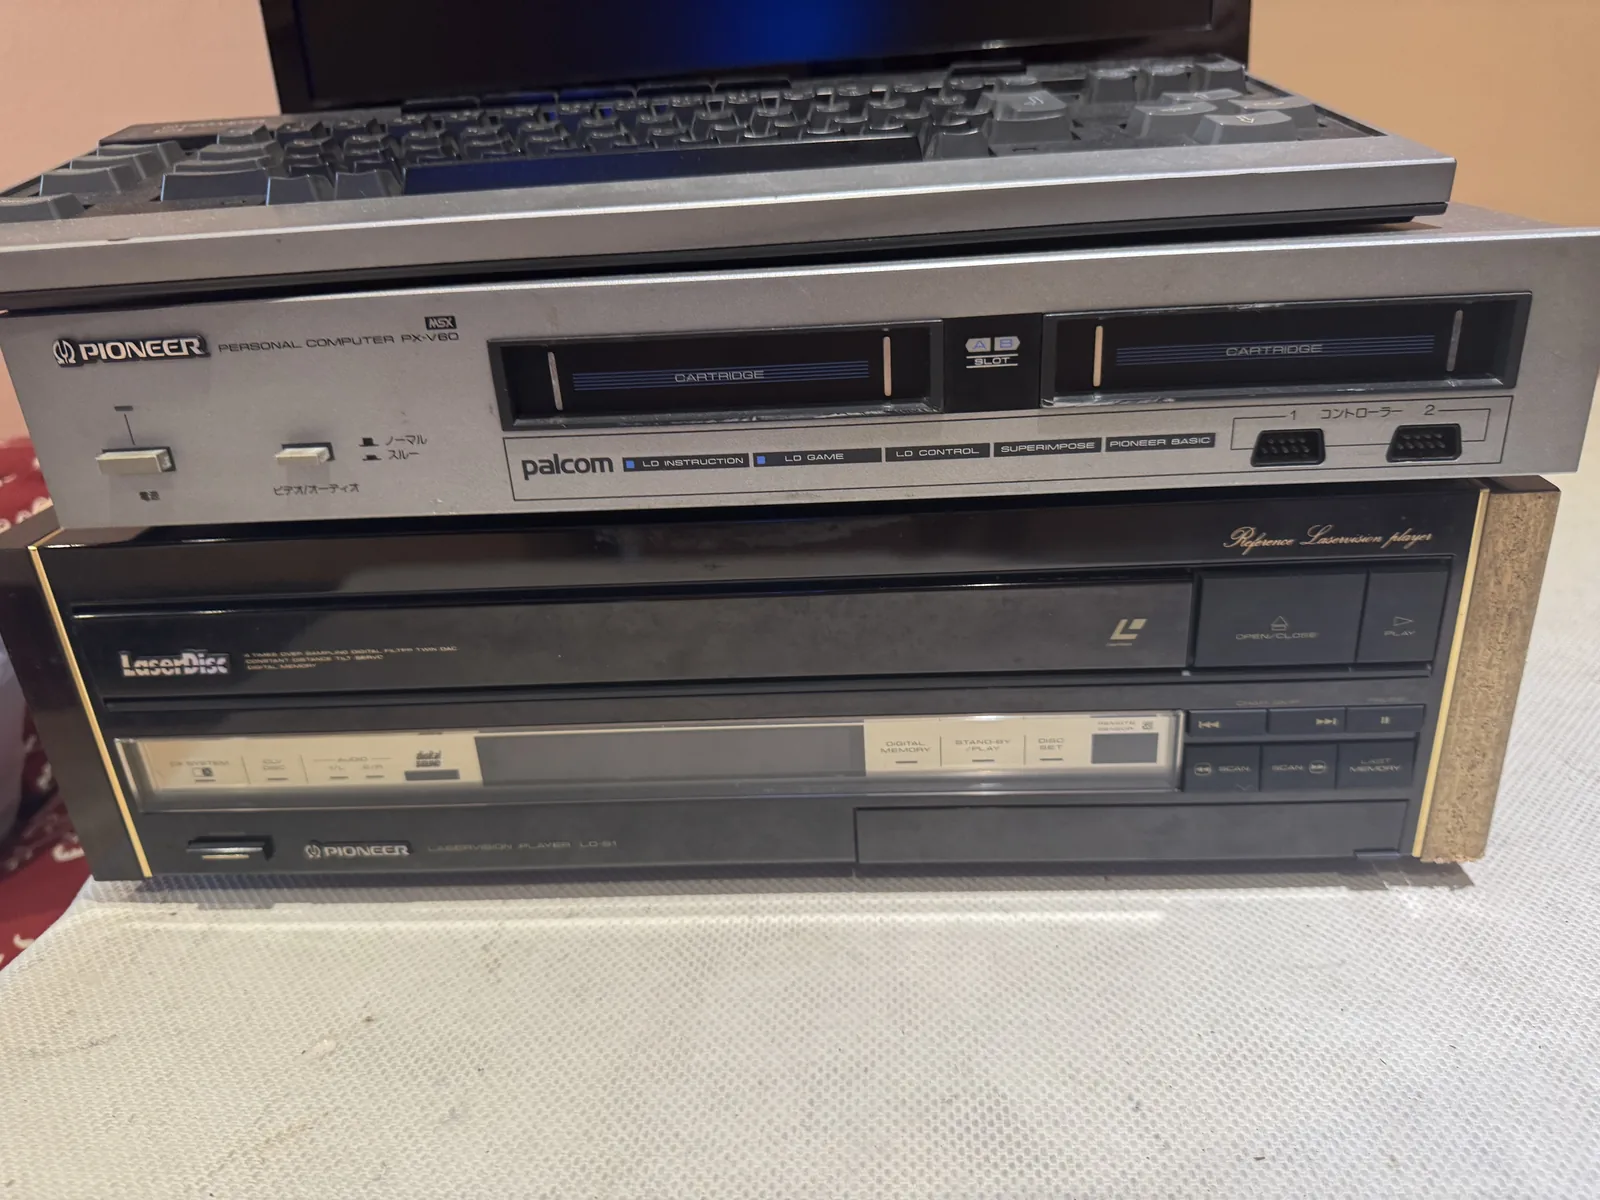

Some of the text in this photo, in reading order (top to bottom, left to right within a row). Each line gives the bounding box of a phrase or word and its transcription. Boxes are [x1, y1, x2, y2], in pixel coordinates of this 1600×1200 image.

[428, 316, 455, 328] MSX
[218, 332, 459, 352] PERSONAL COMPUTER PX-V60
[973, 338, 1012, 350] A B
[79, 336, 205, 361] PIONEER
[1225, 343, 1323, 357] CARTRIDGE
[974, 357, 1010, 366] SLOT
[674, 369, 765, 383] CARTRIDGE
[1289, 404, 1435, 420] 1 コントローラー 2
[385, 434, 427, 446] ノーマル
[1110, 436, 1211, 448] PIONEER BASIC
[896, 448, 980, 458] LD CONTROL
[1001, 442, 1096, 453] SUPERIMPOSE
[388, 450, 419, 460] スルー
[806, 452, 844, 461] GAME
[521, 453, 614, 481] palcom
[642, 457, 744, 468] LD INSTRUCTION
[1223, 524, 1433, 555] Reference Laservision player
[1235, 632, 1318, 640] OPEN/CLOSE
[120, 652, 228, 677] LaserDisc
[1349, 764, 1401, 772] MEMORY
[324, 844, 410, 858] PIONEER
[518, 841, 572, 850] PLAYER
